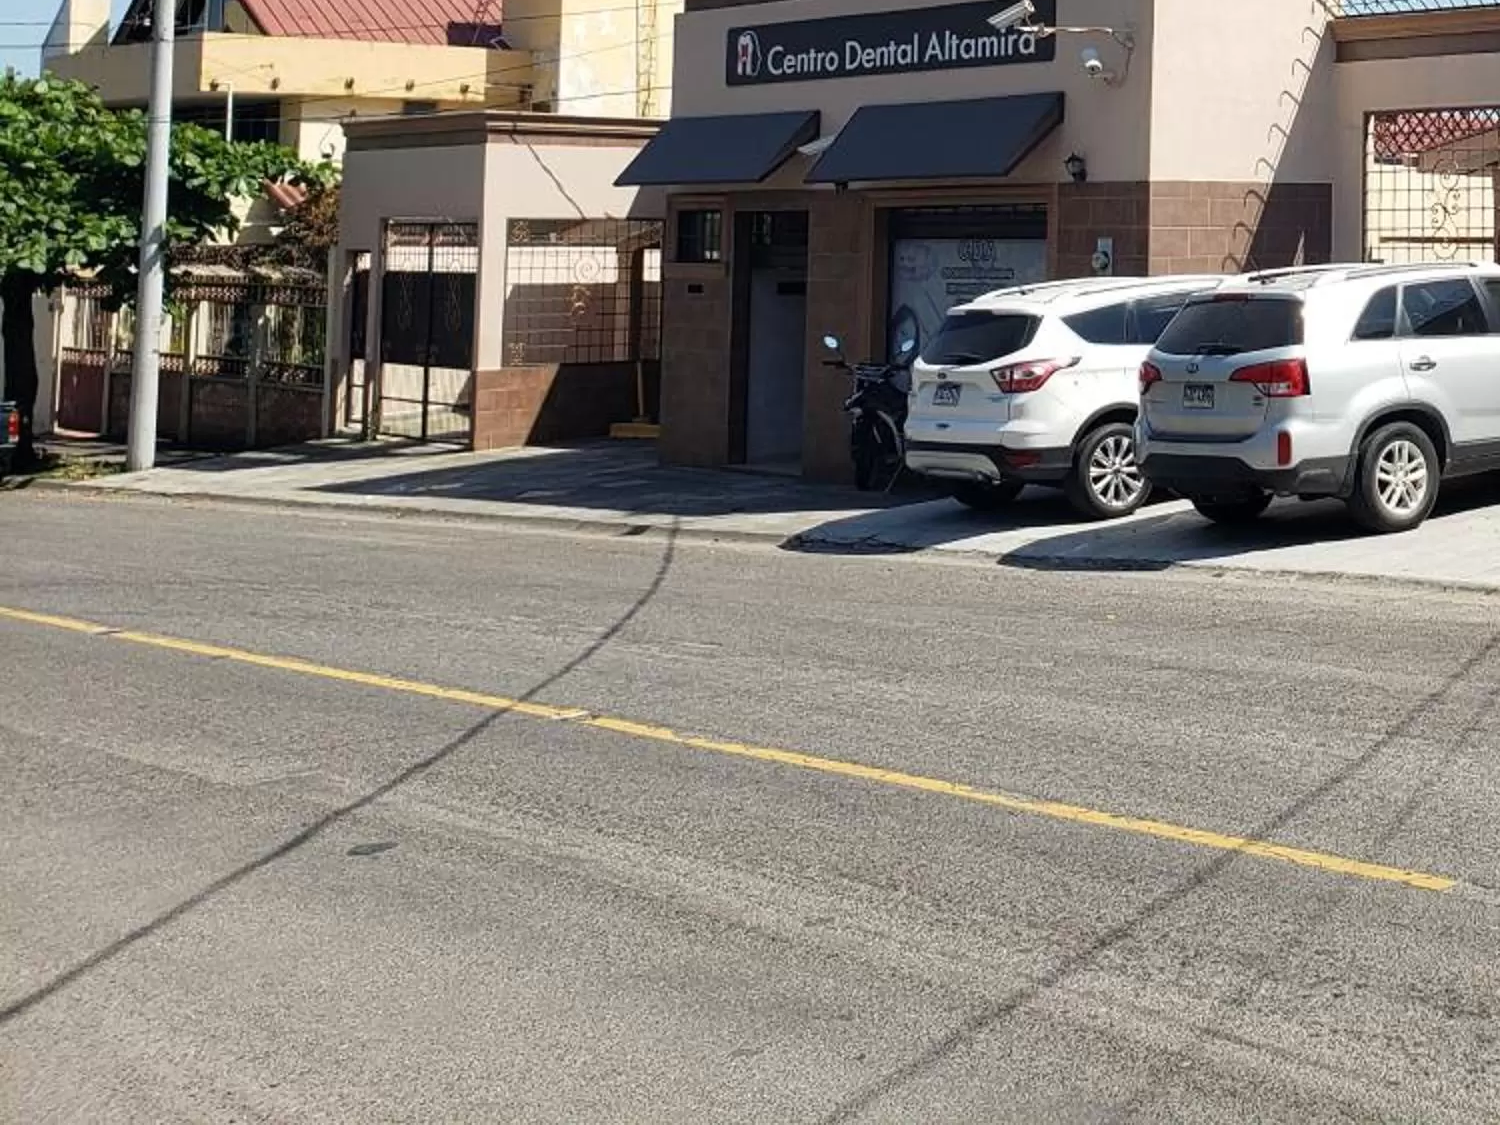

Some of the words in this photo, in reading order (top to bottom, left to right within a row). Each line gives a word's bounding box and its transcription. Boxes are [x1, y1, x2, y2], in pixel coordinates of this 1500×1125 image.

[767, 45, 839, 75] Centro
[845, 32, 919, 70] Dental
[924, 29, 1036, 62] Altamira
